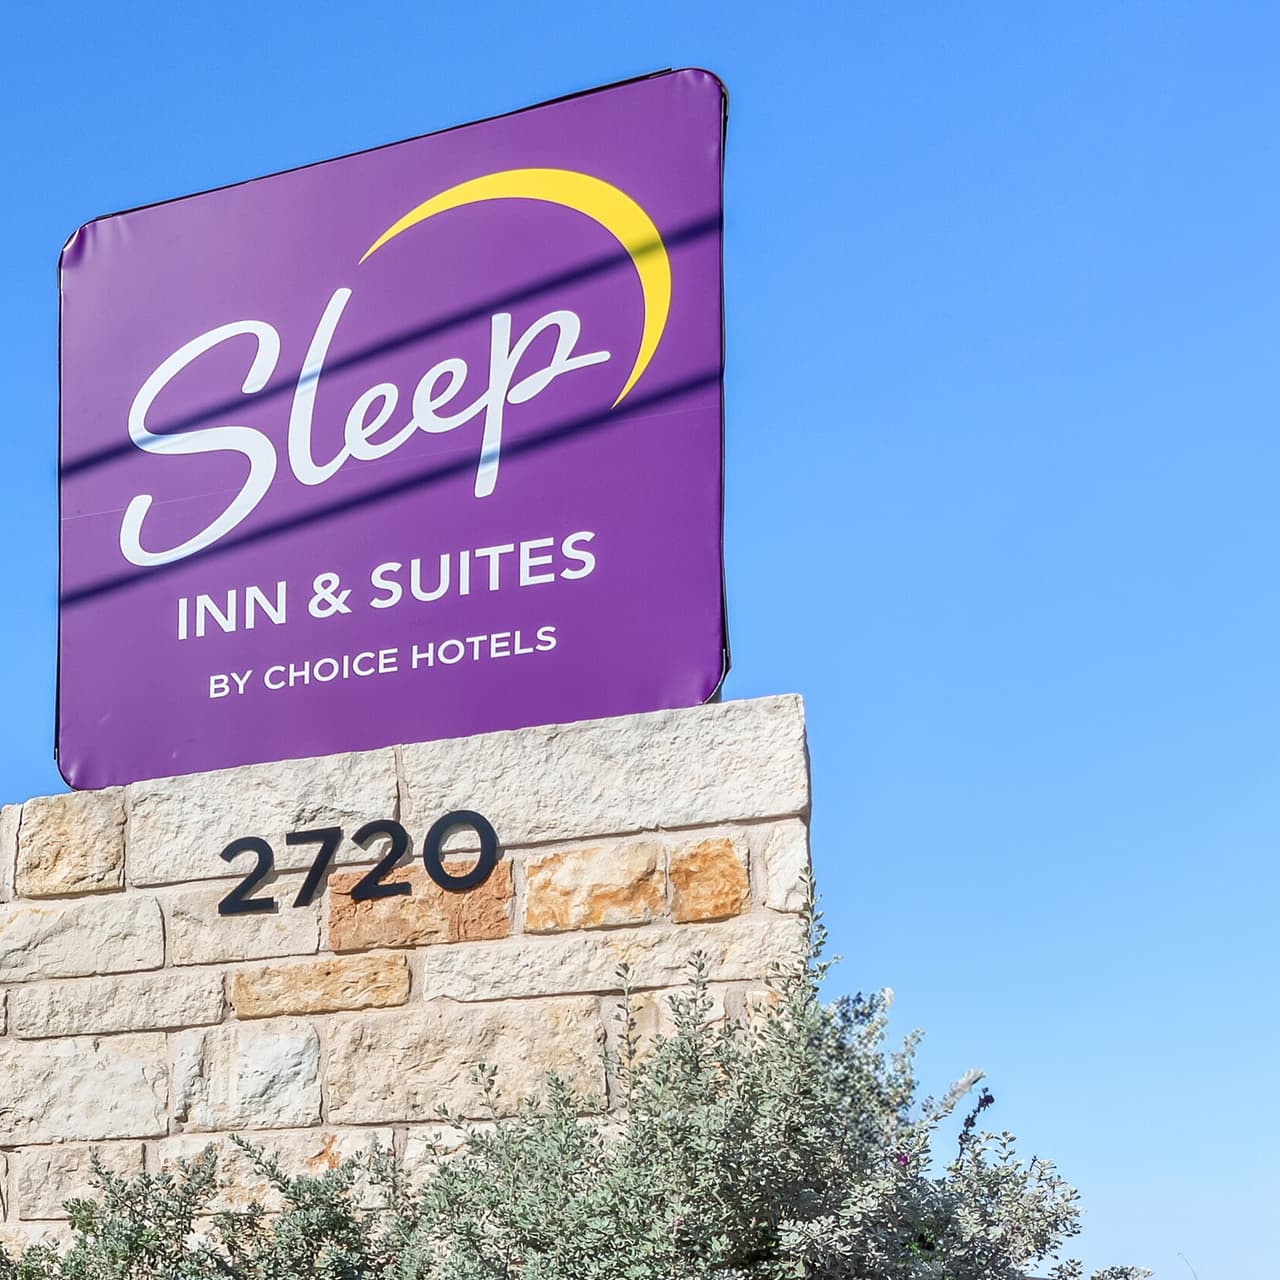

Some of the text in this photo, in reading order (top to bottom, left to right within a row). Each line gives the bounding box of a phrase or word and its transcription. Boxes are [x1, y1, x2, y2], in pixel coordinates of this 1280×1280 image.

[120, 287, 611, 567] Sleep
[176, 530, 597, 641] INN & SUITES
[208, 625, 557, 699] BY CHOICE HOTELS
[218, 809, 499, 914] 2720
